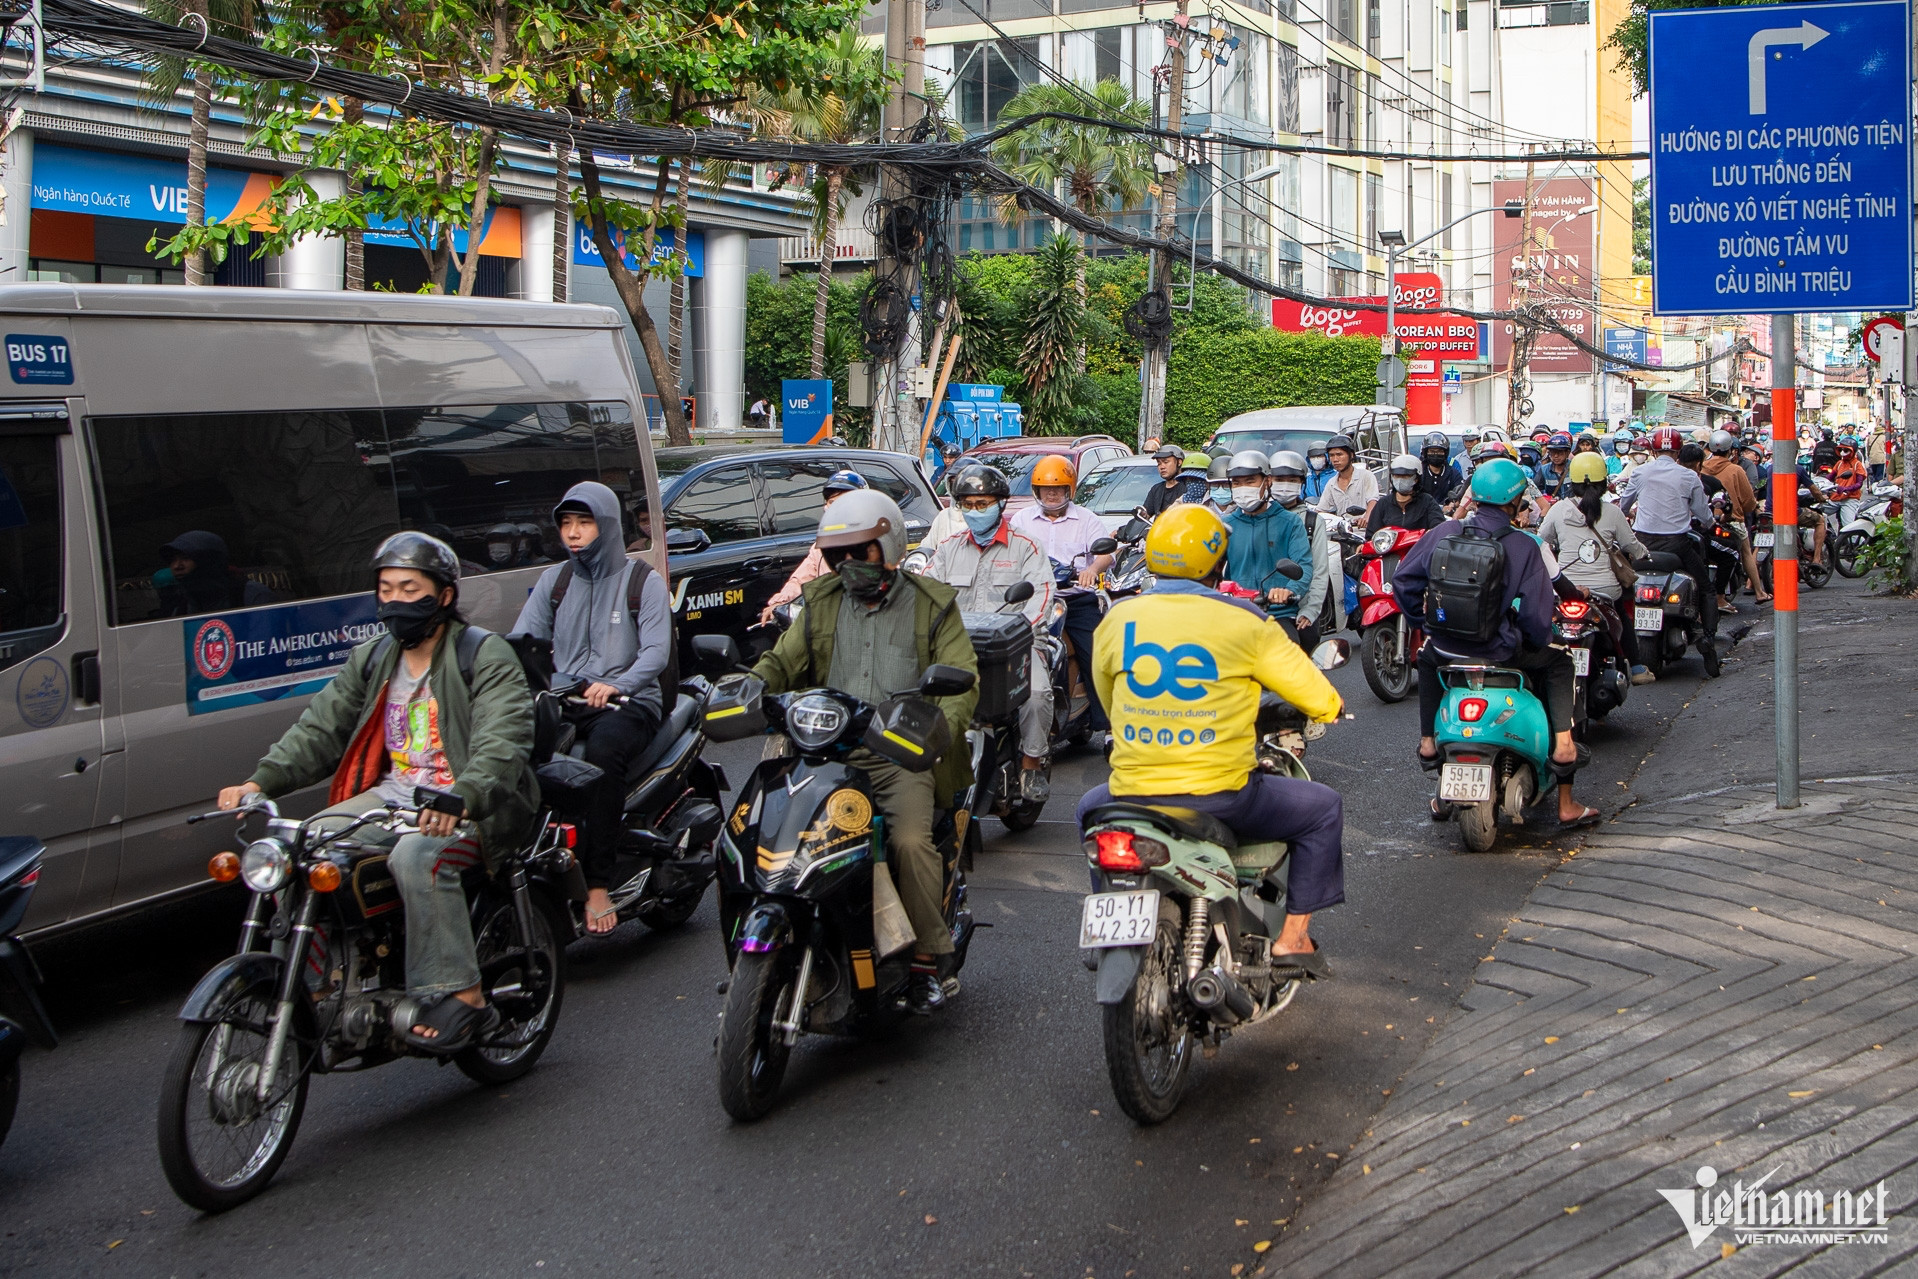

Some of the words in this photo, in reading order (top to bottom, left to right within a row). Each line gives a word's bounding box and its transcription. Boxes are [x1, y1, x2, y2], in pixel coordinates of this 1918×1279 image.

[1660, 124, 1721, 153] HƯỚNG
[1725, 130, 1743, 150] ĐI
[1747, 122, 1781, 150] CÁC
[1785, 124, 1859, 148] PHƯƠNG
[1863, 119, 1903, 150] TIỆN
[1712, 164, 1747, 187] LƯU
[1751, 158, 1811, 185] THÔNG
[1815, 152, 1851, 183] ĐẾN
[34, 184, 62, 202] Ngân
[64, 188, 89, 206] hàng
[91, 191, 118, 207] Quốc
[119, 194, 131, 208] Tế
[150, 184, 189, 214] VIB
[1561, 194, 1586, 205] HÀNH
[1668, 196, 1730, 224] ĐƯỜNG
[1734, 196, 1757, 222] XÔ
[1761, 191, 1798, 221] VIẾT
[1803, 193, 1851, 224] NGHỆ
[1855, 192, 1896, 218] TĨNH
[1718, 230, 1780, 259] ĐƯỜNG
[1783, 226, 1820, 256] TẦM
[1825, 234, 1849, 255] VU
[1715, 264, 1750, 294] CẦU
[1755, 266, 1796, 293] BÌNH
[1801, 266, 1851, 297] TRIỆU
[1394, 325, 1444, 337] KOREAN
[1448, 325, 1476, 339] BBQ
[8, 343, 47, 363] BUS
[50, 345, 67, 363] 17
[1439, 341, 1475, 351] BUFFET
[1617, 341, 1634, 351] NHÀ
[788, 398, 804, 409] VIB
[686, 591, 724, 612] XANH
[725, 588, 744, 605] SM
[686, 611, 702, 621] LIMO
[236, 640, 266, 660] THE
[269, 627, 339, 655] AMERICAN
[341, 621, 389, 643] SCHOO
[1122, 620, 1219, 702] be
[1449, 767, 1483, 782] 59-TA
[1445, 783, 1486, 798] 265.67
[1095, 895, 1144, 919] 50-Y1
[1087, 918, 1151, 942] 142.32
